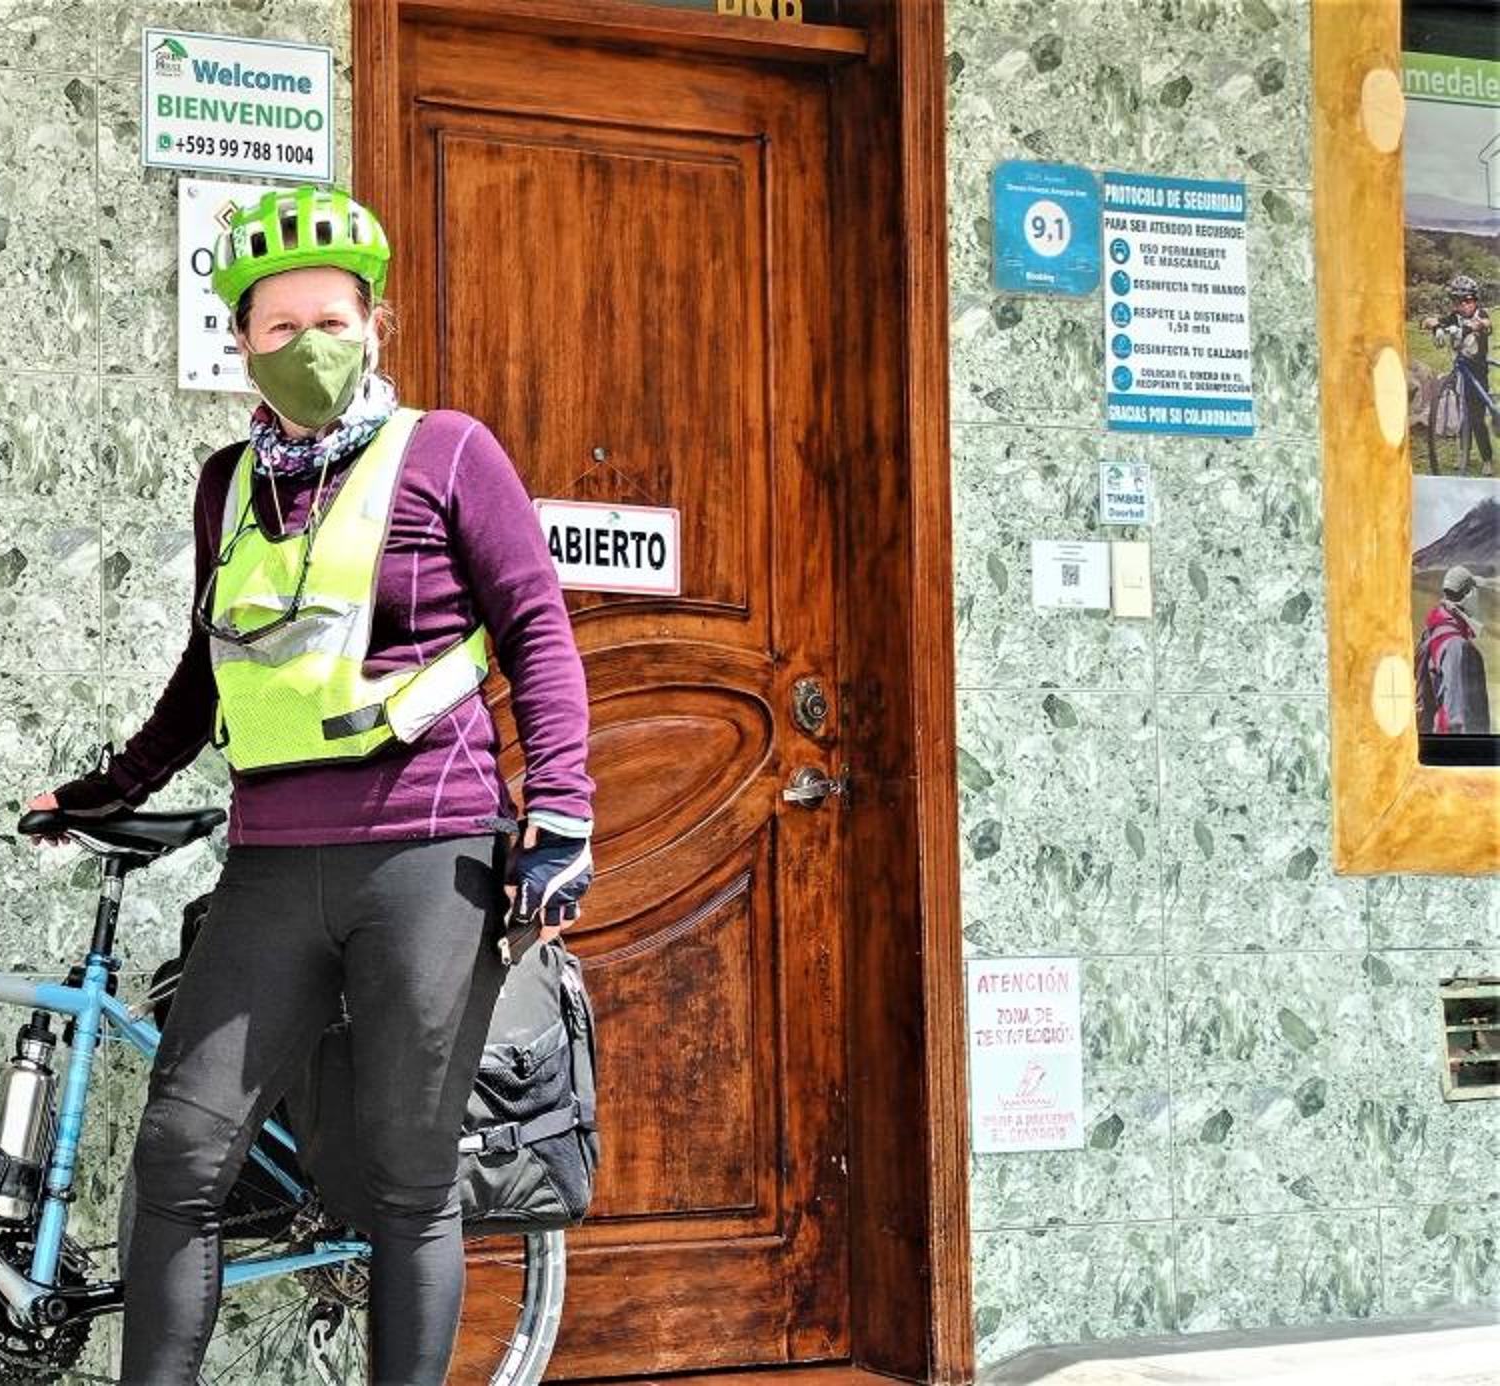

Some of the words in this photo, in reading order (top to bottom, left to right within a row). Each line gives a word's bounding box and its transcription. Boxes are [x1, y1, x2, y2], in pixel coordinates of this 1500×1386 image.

[192, 59, 313, 95] Welcome
[157, 93, 324, 132] BIENVENIDO
[176, 135, 215, 156] +593
[219, 138, 239, 158] 99
[243, 140, 271, 161] 788
[276, 145, 314, 165] 1004
[1105, 183, 1165, 207] PROTOCOLO
[1167, 189, 1181, 208] DE
[1183, 190, 1243, 212] SEGURIDAD
[1032, 215, 1064, 242] 9,1
[1105, 218, 1128, 232] PARA
[1130, 219, 1148, 233] SER
[1150, 221, 1193, 237] ATENDIDO
[1140, 243, 1159, 255] USO
[1162, 245, 1227, 259] PERMANENTE
[1143, 255, 1156, 267] DE
[1159, 256, 1221, 271] MASCARILLA
[1133, 279, 1188, 293] DESINFECTA
[1191, 282, 1209, 294] TUS
[1212, 283, 1247, 296] MANOS
[1133, 307, 1176, 321] RESPETE
[1179, 310, 1191, 322] LA
[1193, 311, 1245, 324] DISTANCIA
[1133, 343, 1189, 358] DESINFECTA
[1207, 347, 1250, 360] CALZADO
[1109, 404, 1148, 423] GRACIAS
[1149, 406, 1168, 424] POR
[1170, 407, 1182, 424] SU
[1105, 493, 1146, 505] TIMBRE
[548, 525, 667, 571] ABIERTO
[977, 965, 1070, 994] ATENCIÓN
